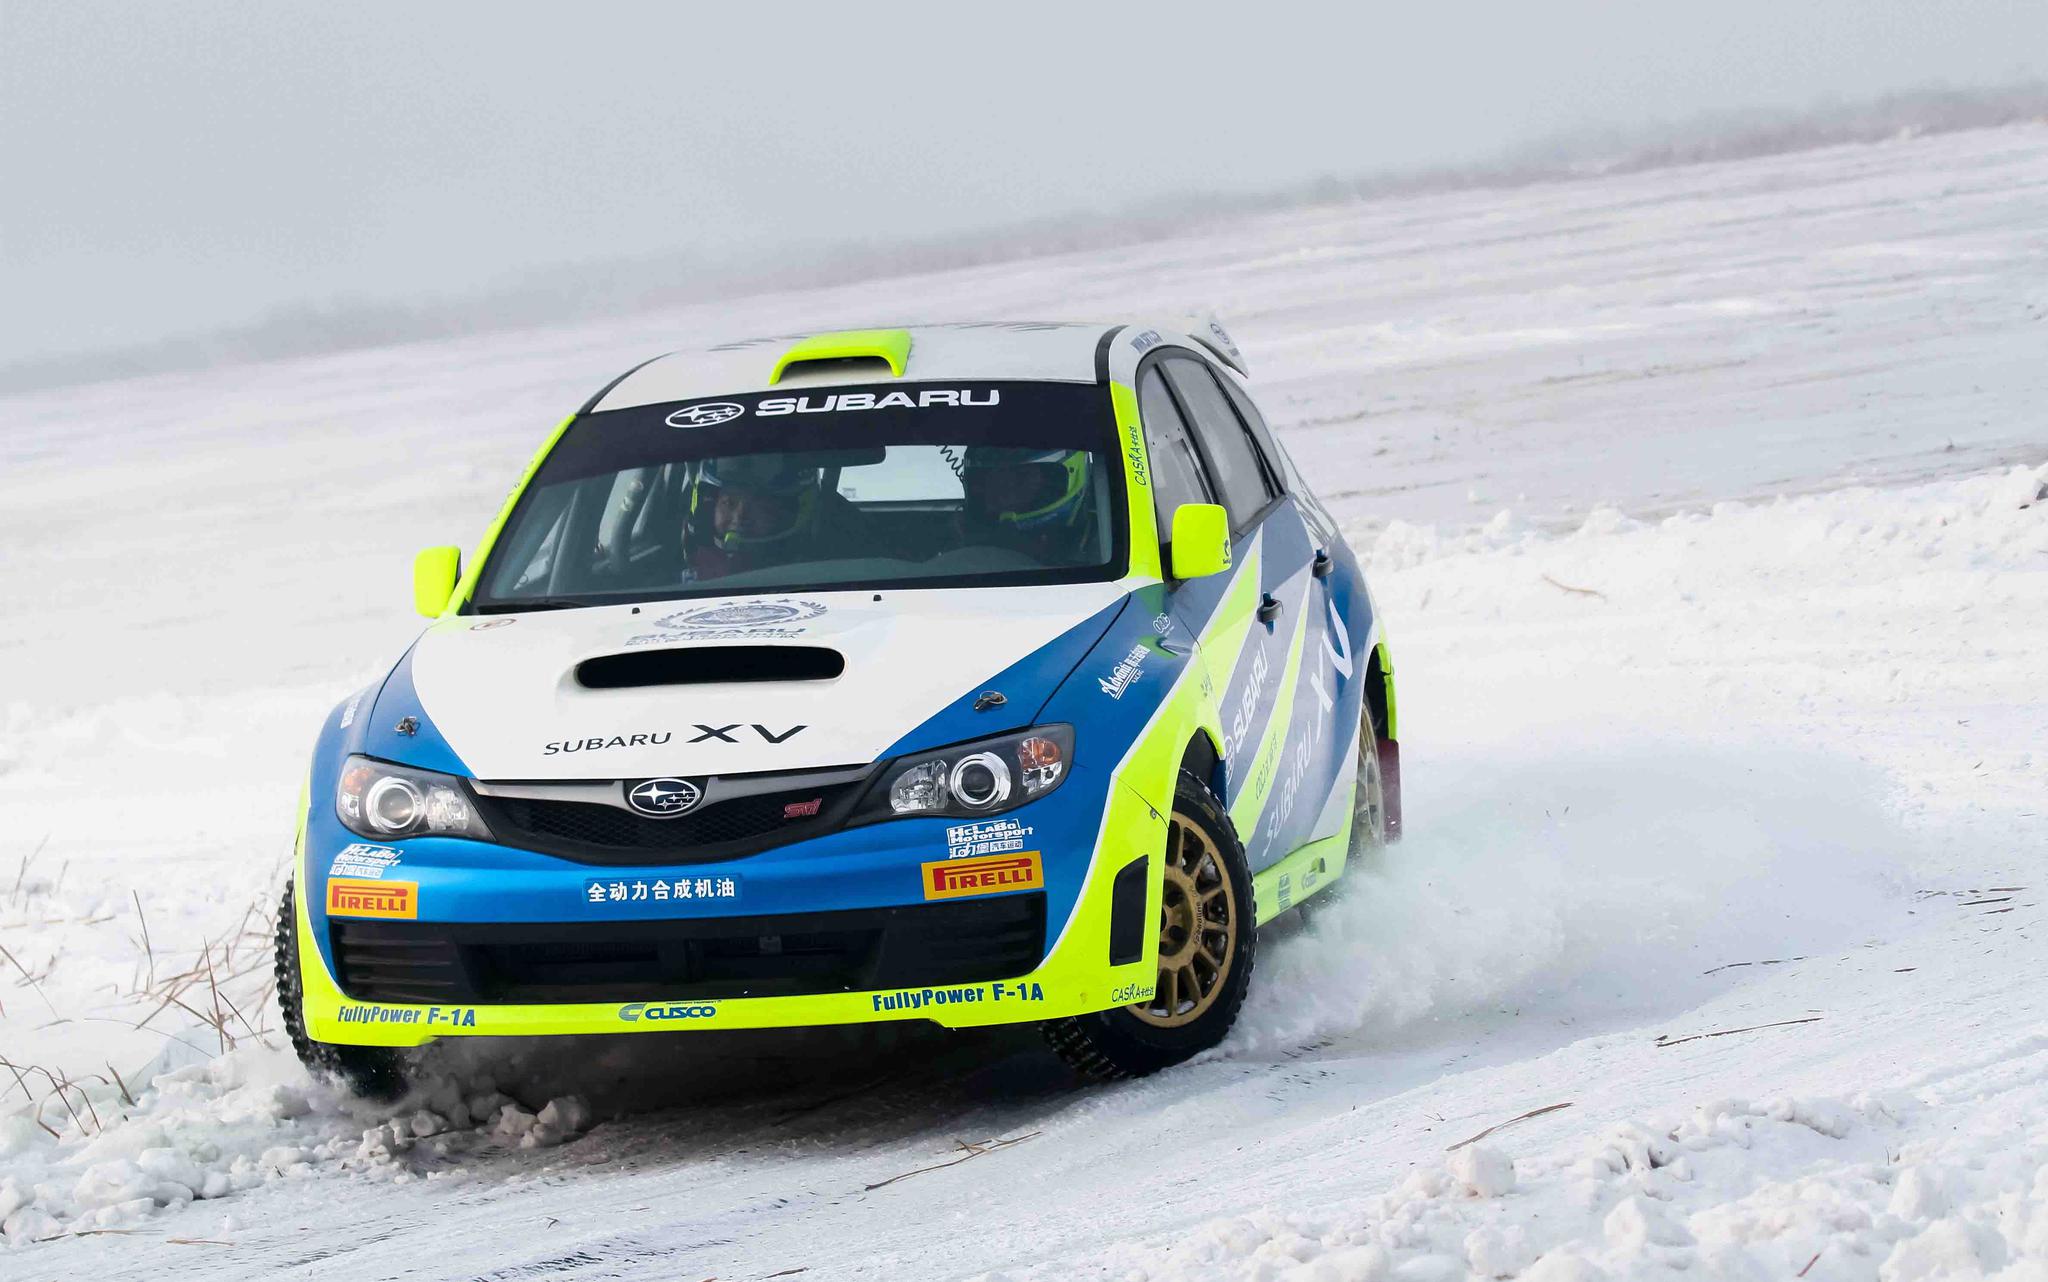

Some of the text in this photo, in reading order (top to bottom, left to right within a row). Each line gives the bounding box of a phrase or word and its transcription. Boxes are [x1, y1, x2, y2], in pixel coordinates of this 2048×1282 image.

[755, 389, 1000, 416] SUBARU
[1233, 639, 1269, 754] SUBARU
[543, 724, 809, 756] SUBARU XV
[1262, 720, 1312, 857] SUBARU
[1310, 598, 1354, 746] XV
[932, 858, 1033, 891] PIRELLI
[331, 885, 408, 912] PIRELLI
[587, 878, 736, 903] 全动力合成机油
[872, 983, 1044, 1012] FullyPower F-1A
[1111, 983, 1140, 1003] CASKA
[337, 1005, 476, 1027] FullyPower F-1A
[645, 1006, 717, 1020] CUSCO
